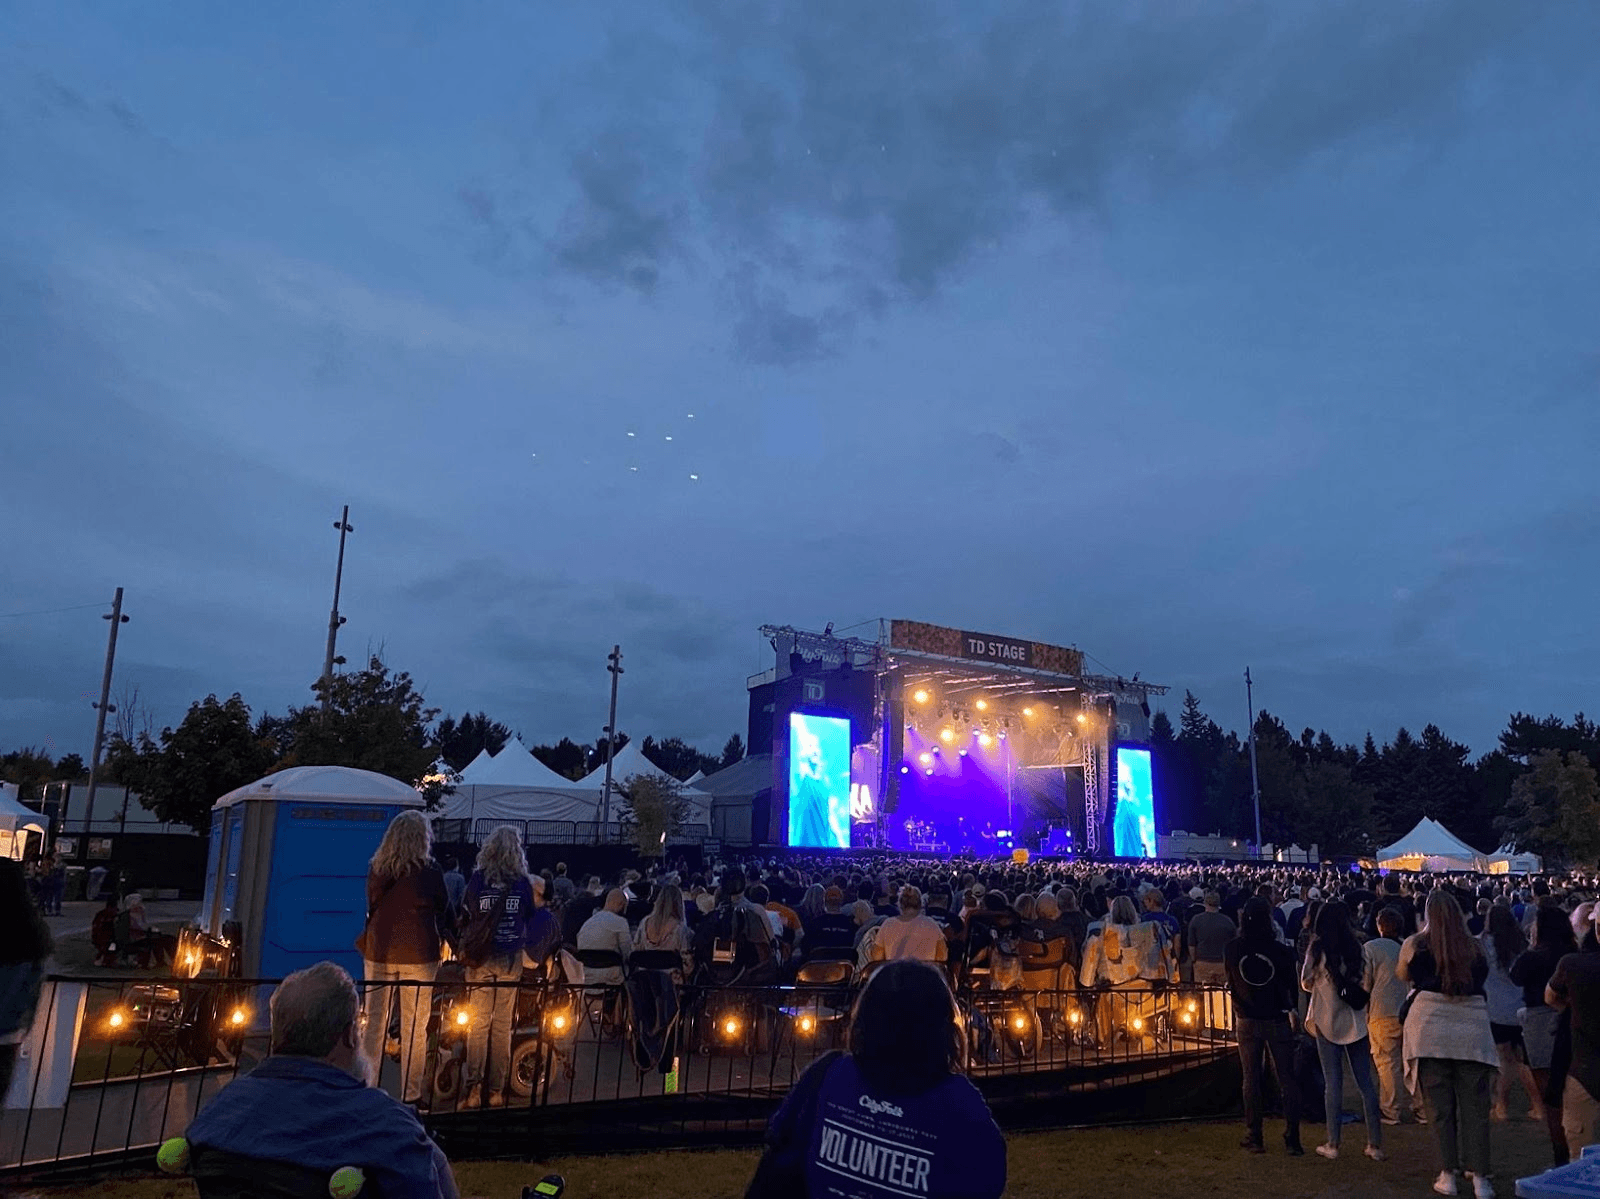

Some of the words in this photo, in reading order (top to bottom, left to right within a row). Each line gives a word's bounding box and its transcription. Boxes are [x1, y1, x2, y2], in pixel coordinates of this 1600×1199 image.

[968, 639, 986, 655] TD
[988, 642, 1026, 661] STAGE
[804, 683, 824, 700] TD
[819, 1125, 931, 1192] VOLUNTEER
